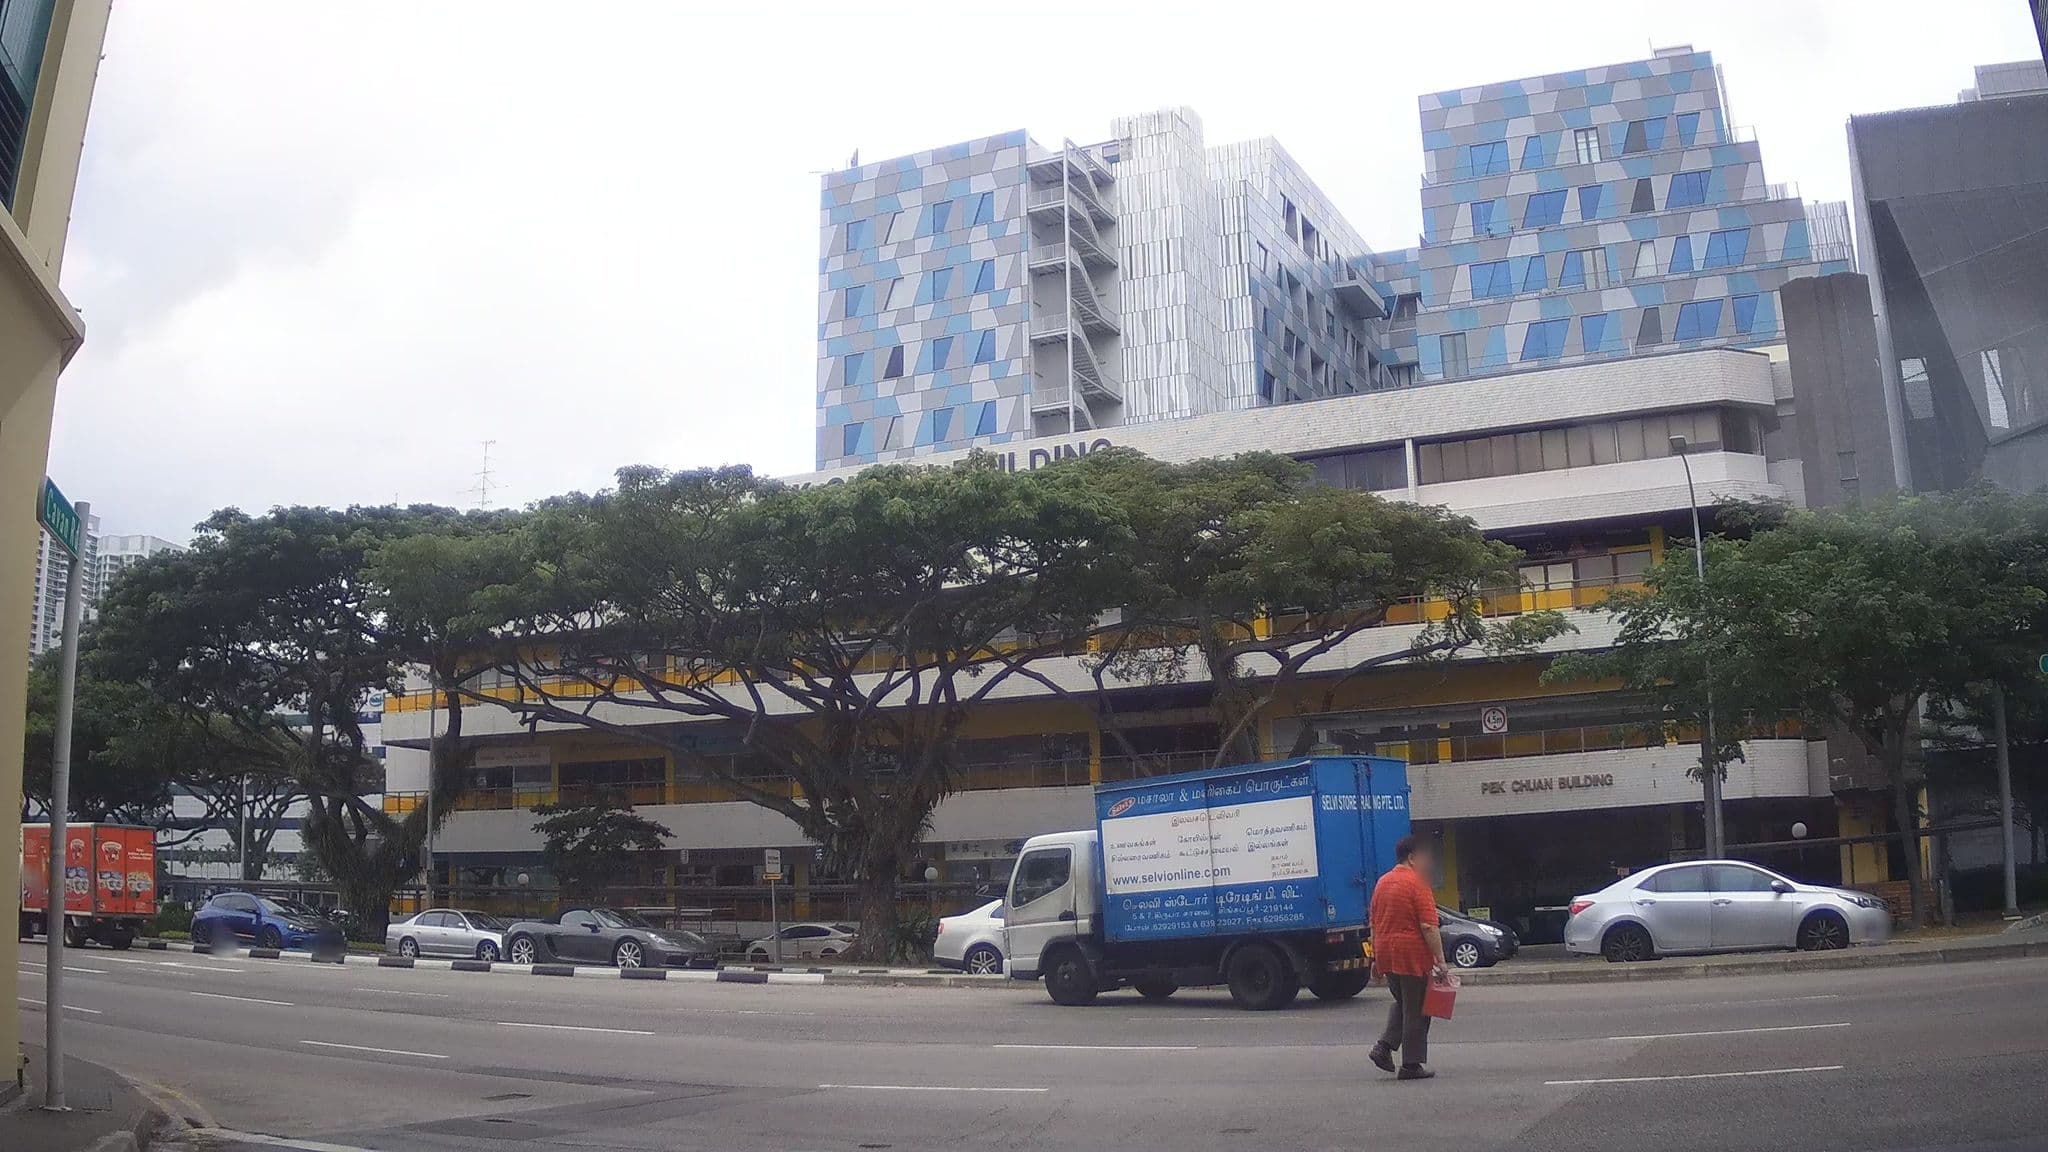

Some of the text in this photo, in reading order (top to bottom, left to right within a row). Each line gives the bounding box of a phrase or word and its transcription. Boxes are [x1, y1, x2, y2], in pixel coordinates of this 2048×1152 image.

[1180, 788, 1189, 802] &
[1246, 773, 1309, 793] பொருட்கள்
[1481, 773, 1614, 794] PEK CHUAN BUILDING
[1322, 795, 1338, 810] SELVI
[1338, 795, 1357, 810] STORE
[1112, 867, 1231, 885] www.selvionline.com
